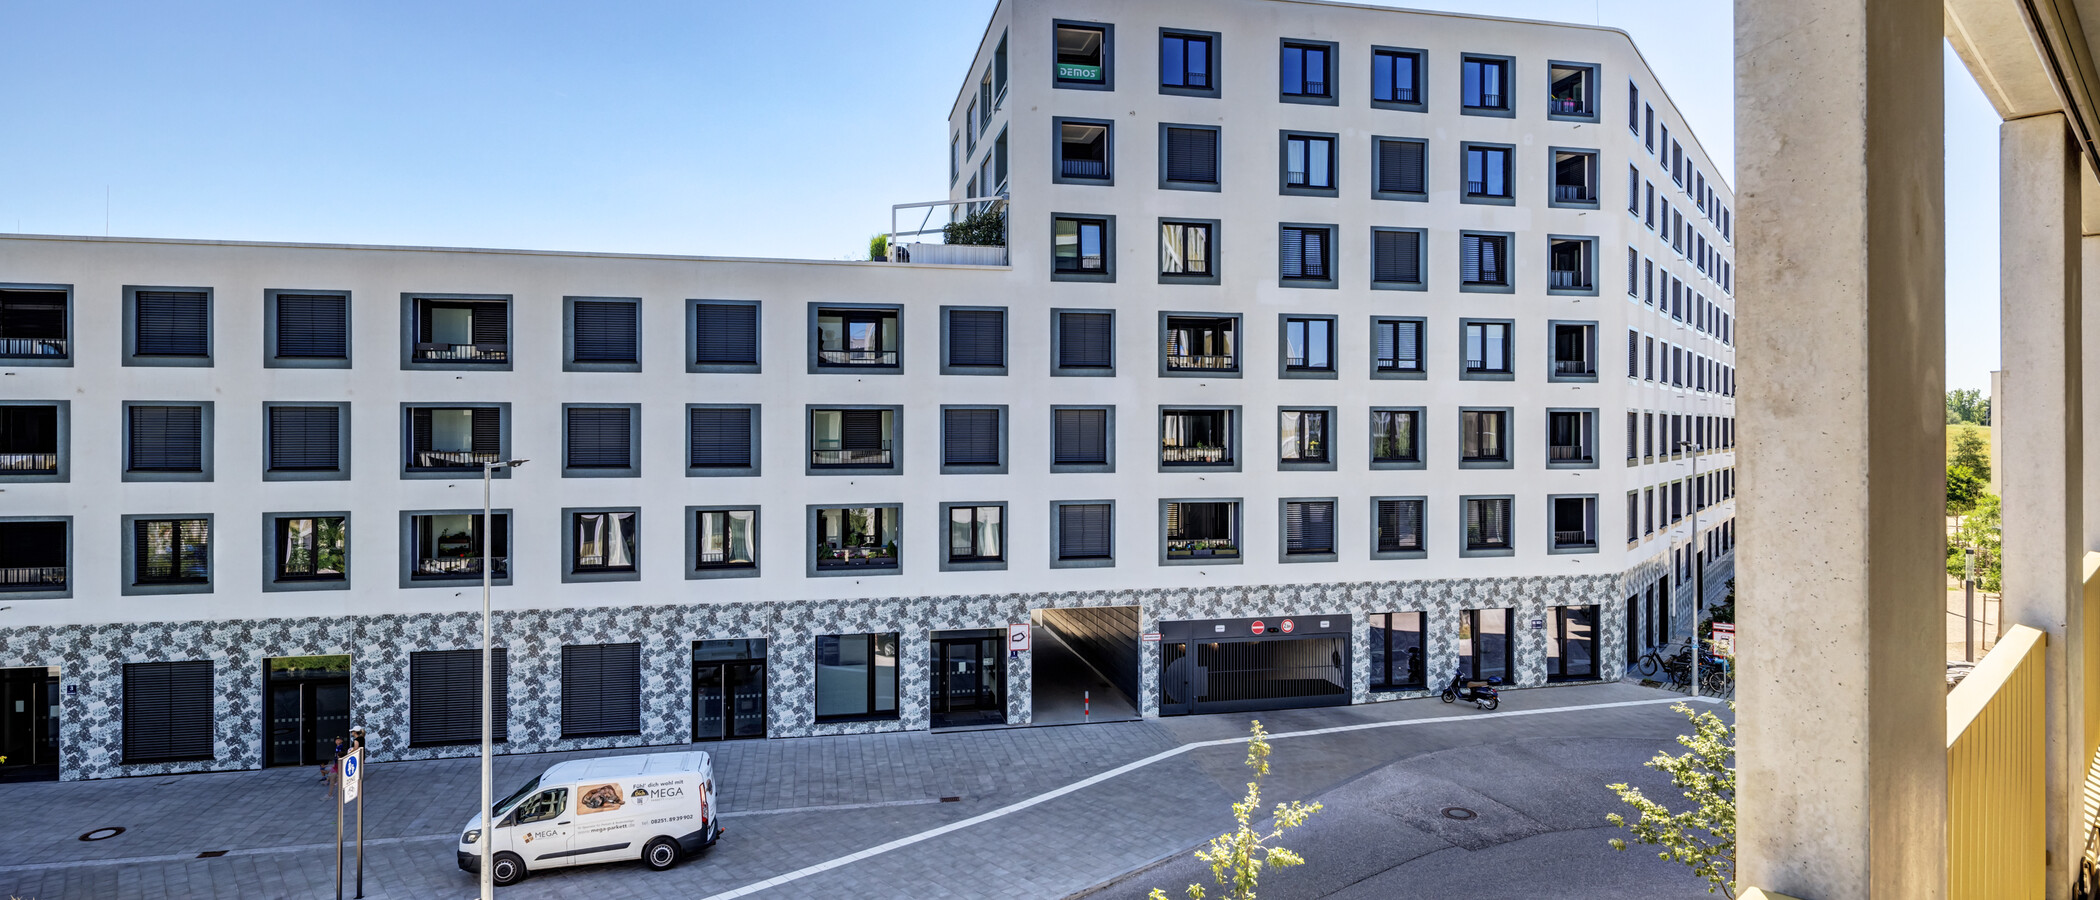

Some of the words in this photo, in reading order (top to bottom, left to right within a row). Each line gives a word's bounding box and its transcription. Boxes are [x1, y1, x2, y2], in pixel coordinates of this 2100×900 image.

[1060, 67, 1096, 78] DEMOS
[650, 787, 684, 798] MEGA
[534, 829, 558, 838] MEGA
